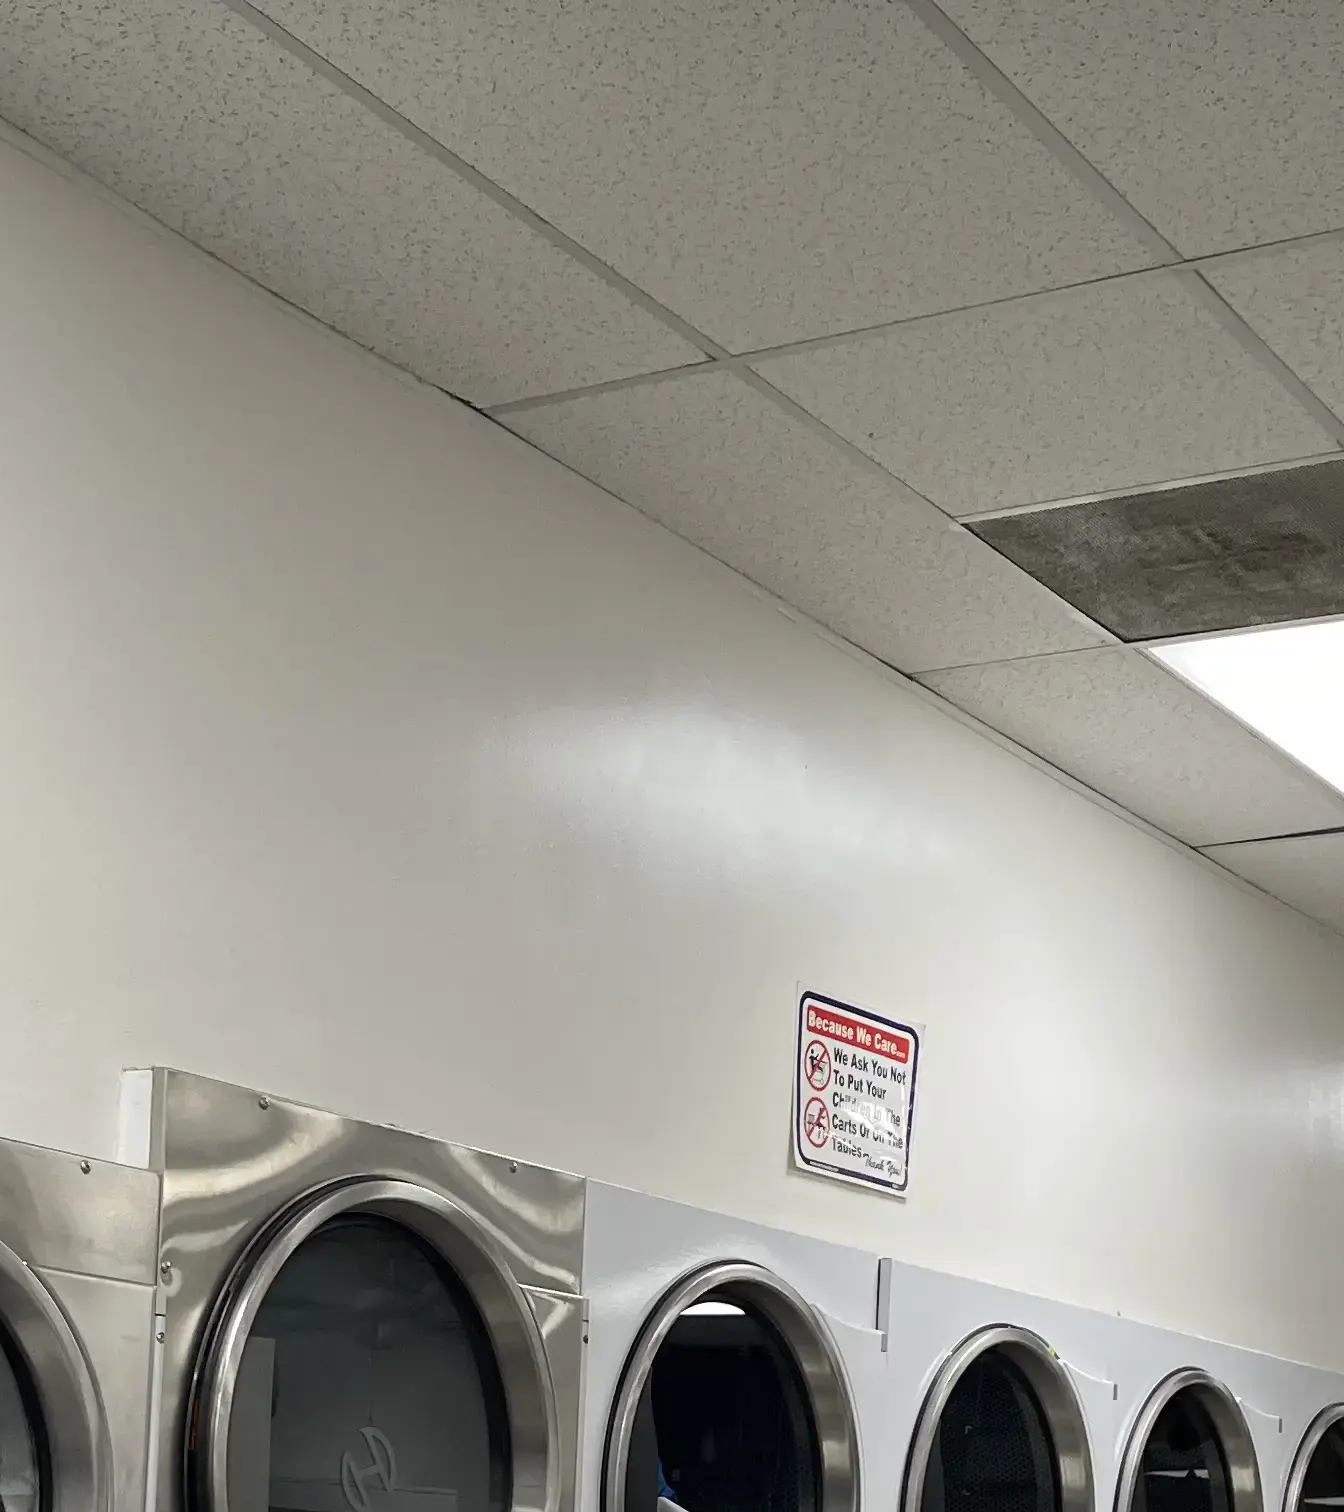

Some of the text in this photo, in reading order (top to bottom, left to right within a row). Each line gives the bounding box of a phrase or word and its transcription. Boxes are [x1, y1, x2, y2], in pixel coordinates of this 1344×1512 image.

[808, 1010, 854, 1040] Because
[857, 1026, 872, 1046] We
[833, 1047, 906, 1085] We Ask You Not
[833, 1069, 887, 1099] To Put Your
[832, 1113, 857, 1135] Carts
